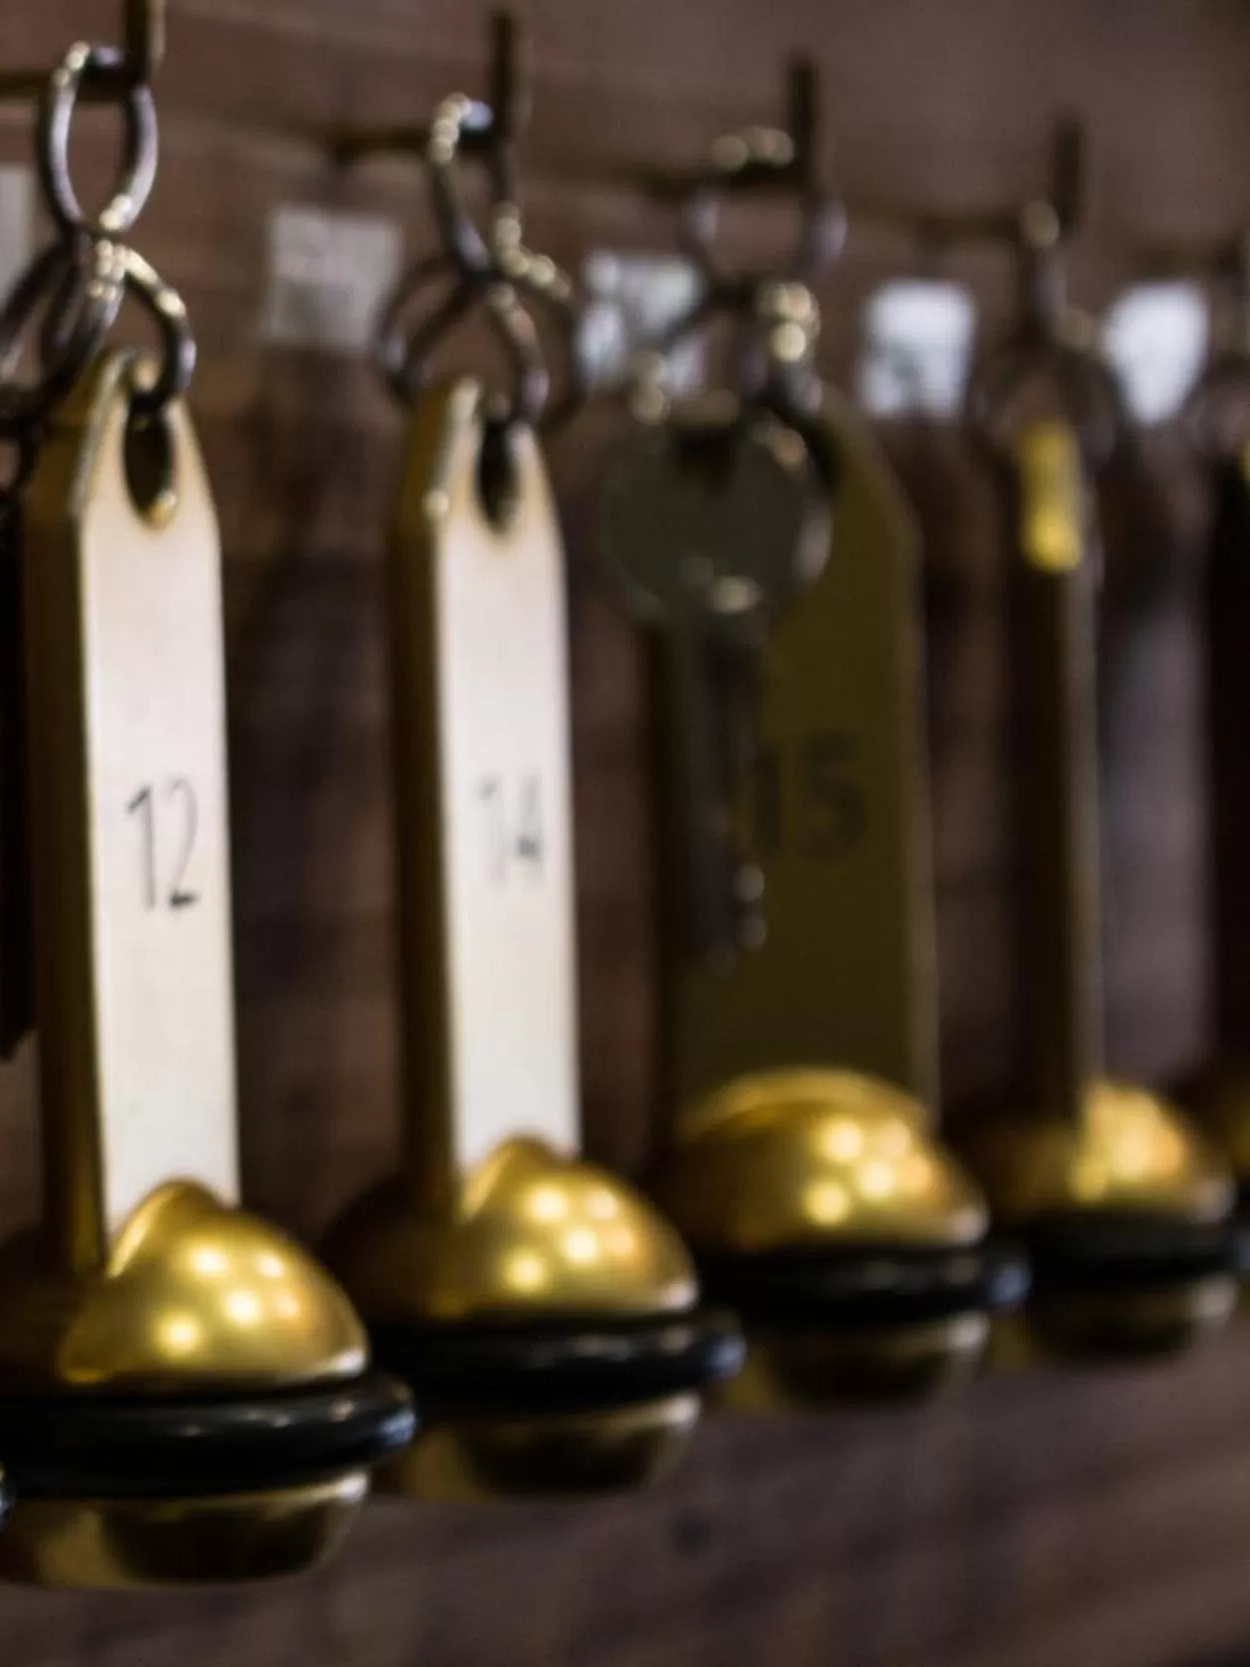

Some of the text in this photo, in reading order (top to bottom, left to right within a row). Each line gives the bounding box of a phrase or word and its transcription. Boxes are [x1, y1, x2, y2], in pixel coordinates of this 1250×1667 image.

[127, 776, 200, 911] 12
[479, 774, 545, 889] 14
[753, 728, 871, 860] 15
